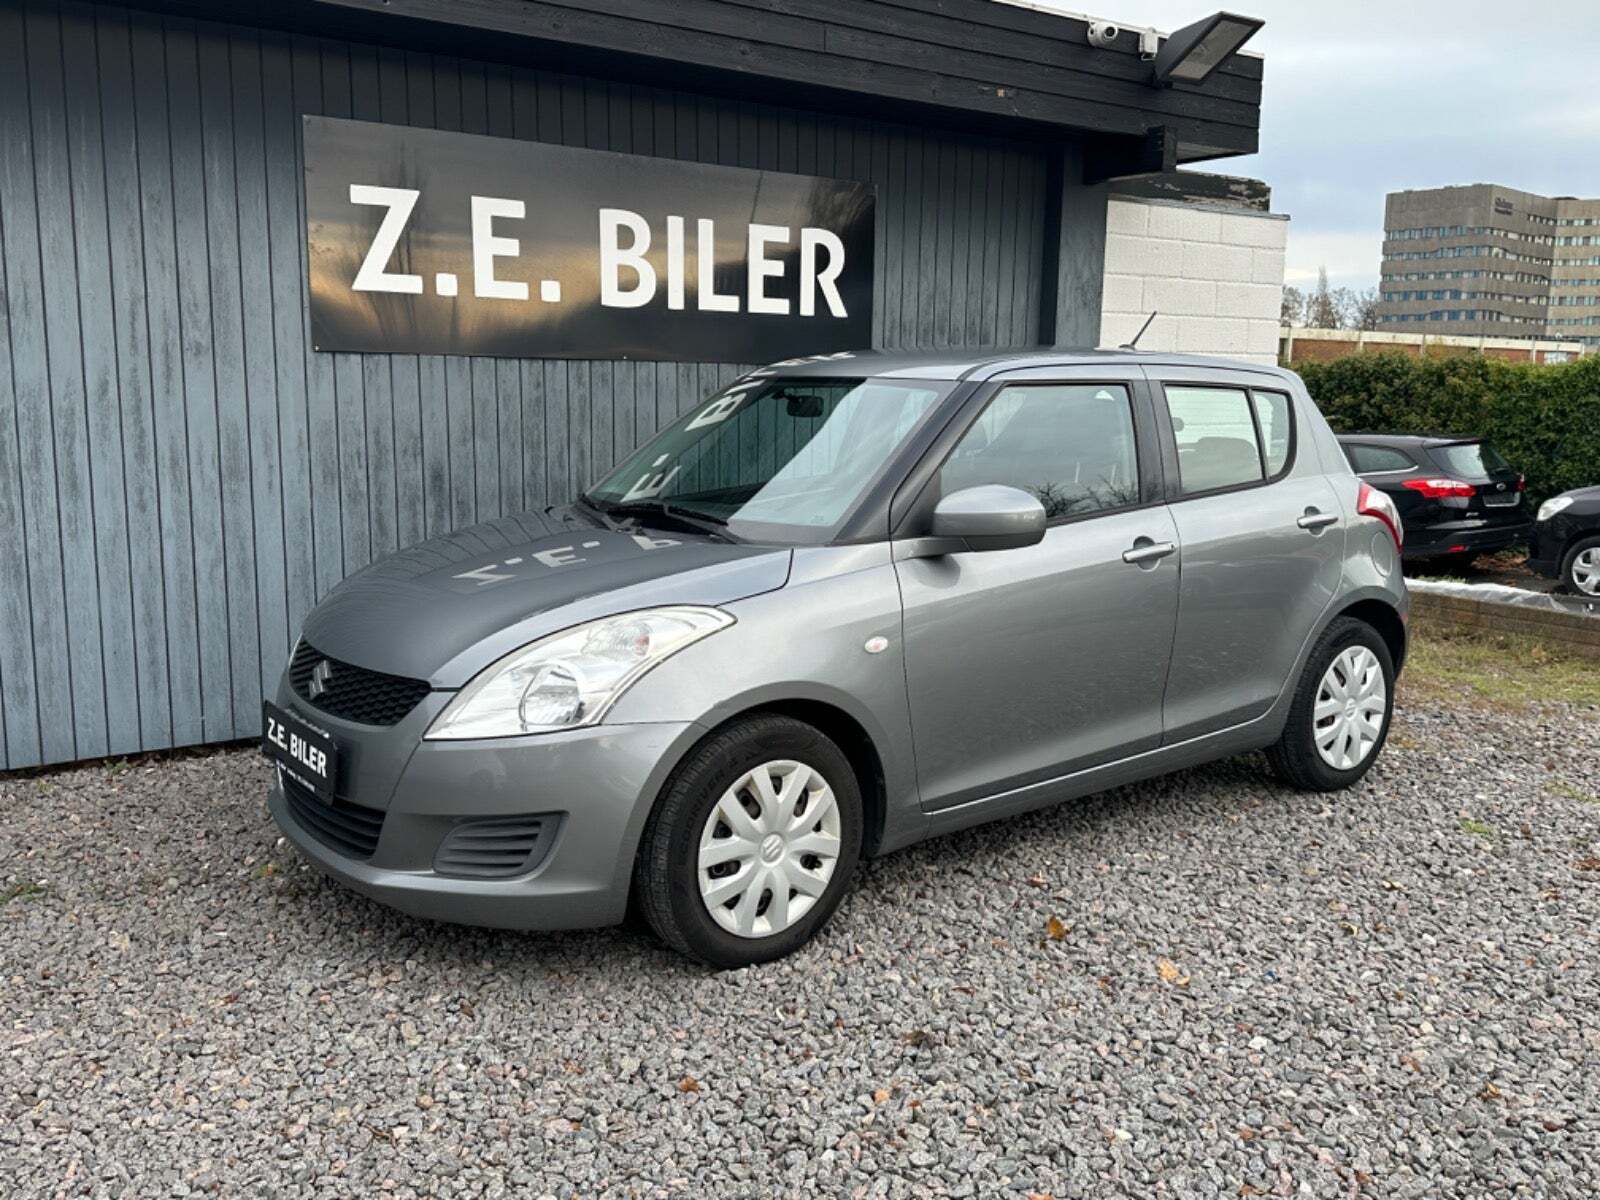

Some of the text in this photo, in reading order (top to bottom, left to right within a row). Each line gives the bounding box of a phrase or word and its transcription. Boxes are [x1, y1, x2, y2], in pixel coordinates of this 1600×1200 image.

[349, 184, 848, 318] Z.E. BILER
[290, 732, 327, 778] BILER
